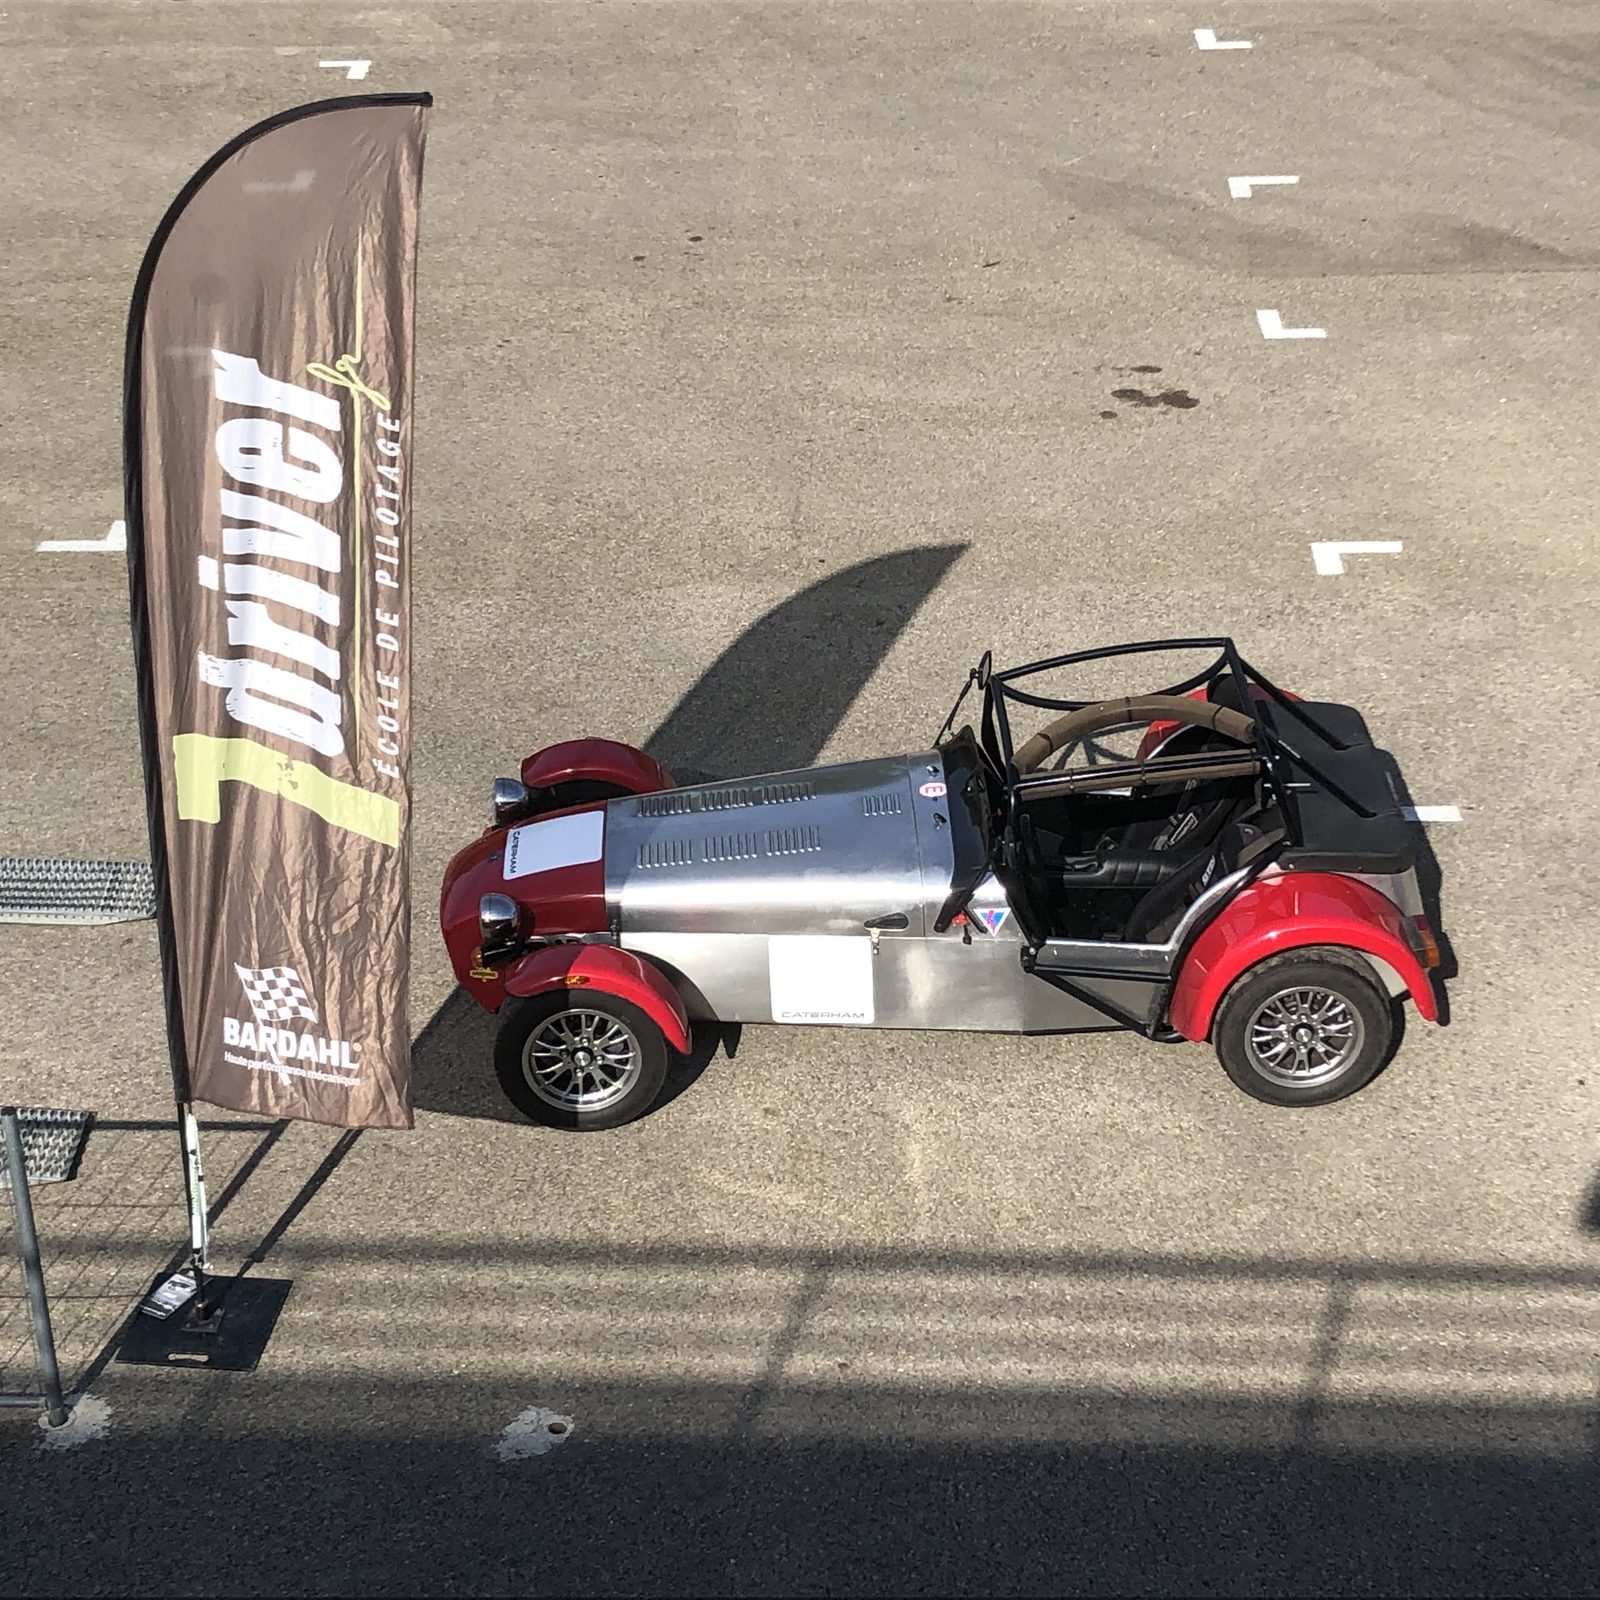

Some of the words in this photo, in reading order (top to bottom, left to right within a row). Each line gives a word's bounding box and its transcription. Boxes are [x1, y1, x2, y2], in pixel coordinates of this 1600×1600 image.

[375, 412, 401, 589] PILOTAGE
[375, 607, 400, 652] DE
[372, 669, 400, 779] ÉCOLE
[509, 830, 521, 874] CATERHAM
[781, 1011, 865, 1019] CATERHAM
